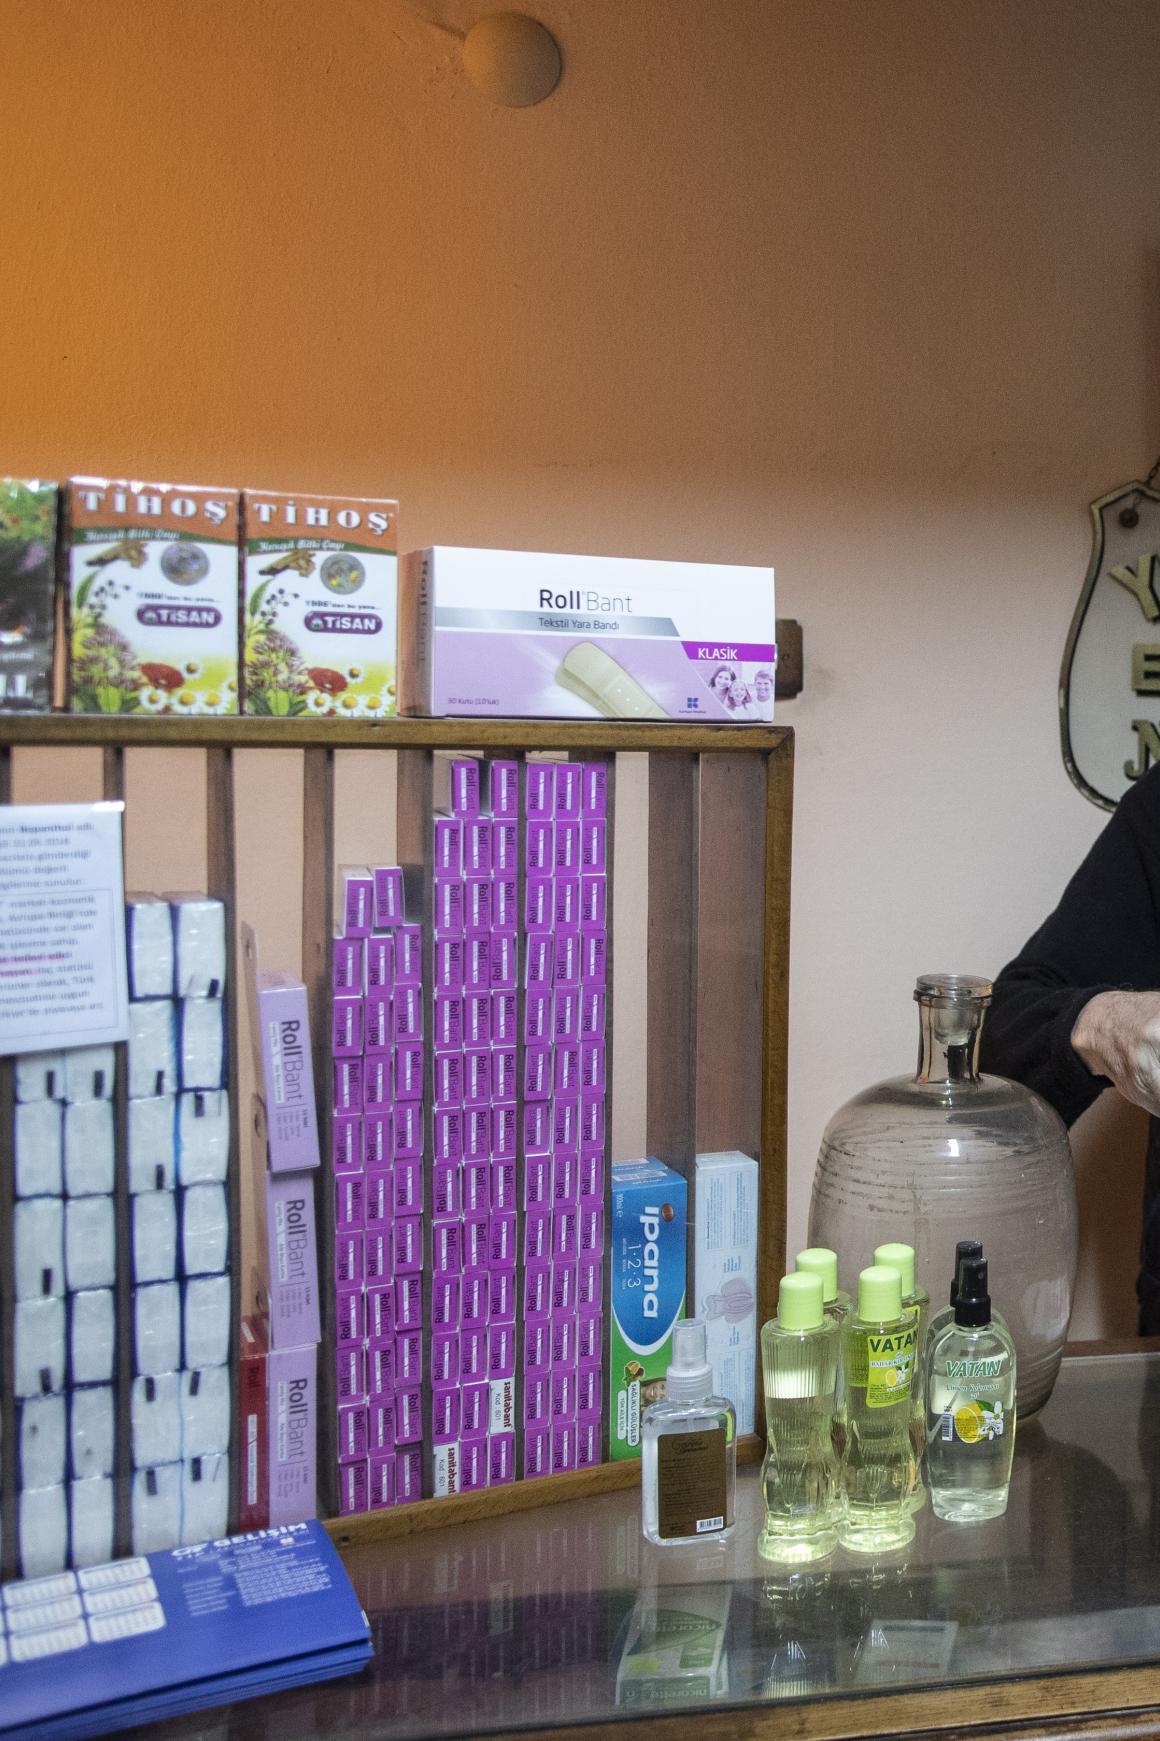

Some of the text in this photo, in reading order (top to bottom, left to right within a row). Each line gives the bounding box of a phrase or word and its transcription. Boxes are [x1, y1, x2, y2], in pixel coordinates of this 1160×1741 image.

[79, 489, 228, 524] TİHOŞ
[253, 501, 390, 536] TİHOŞ
[538, 618, 619, 631] Tekstil Yara Bandı
[698, 646, 738, 660] KLASİK
[639, 1203, 672, 1319] ipana
[869, 1330, 918, 1352] VATAN
[946, 1358, 1001, 1378] VATAN
